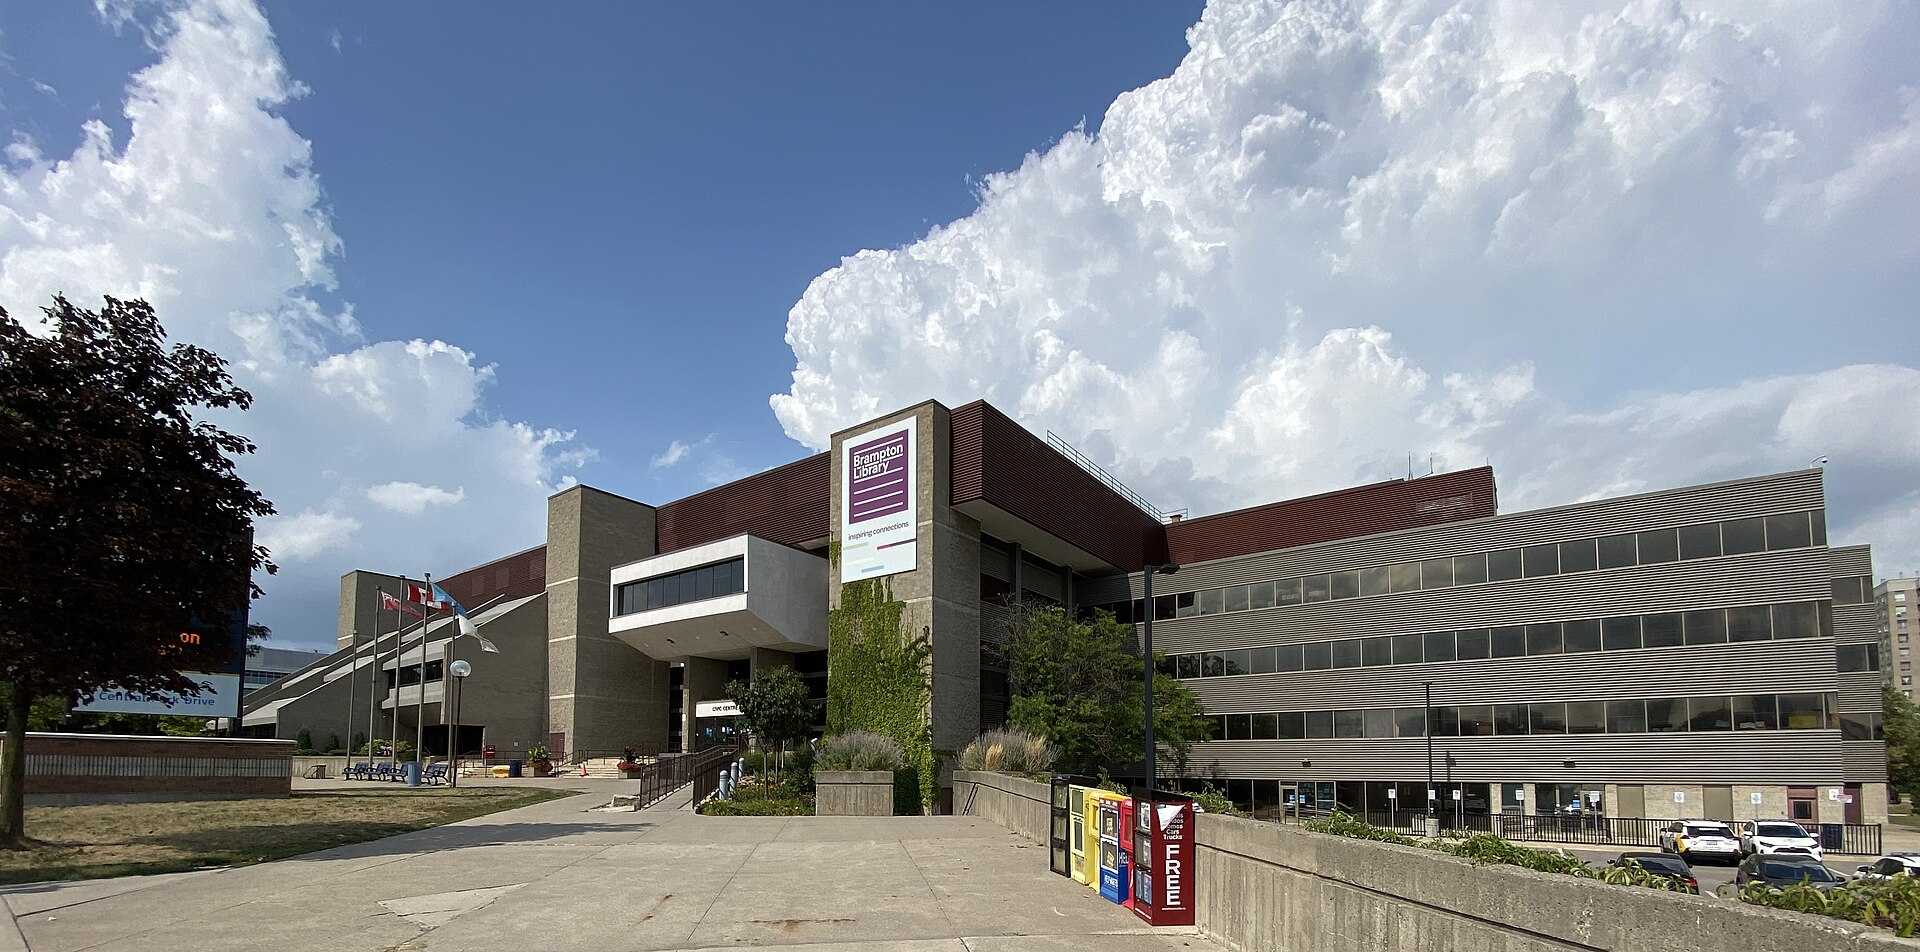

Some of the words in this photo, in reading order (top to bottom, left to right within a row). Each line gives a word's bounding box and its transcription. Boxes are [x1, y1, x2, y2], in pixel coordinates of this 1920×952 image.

[853, 444, 904, 467] Brampton
[853, 460, 890, 480] Library
[848, 528, 873, 541] inspiring
[873, 521, 909, 535] connections
[184, 696, 215, 706] Drive
[1165, 844, 1181, 906] FREE
